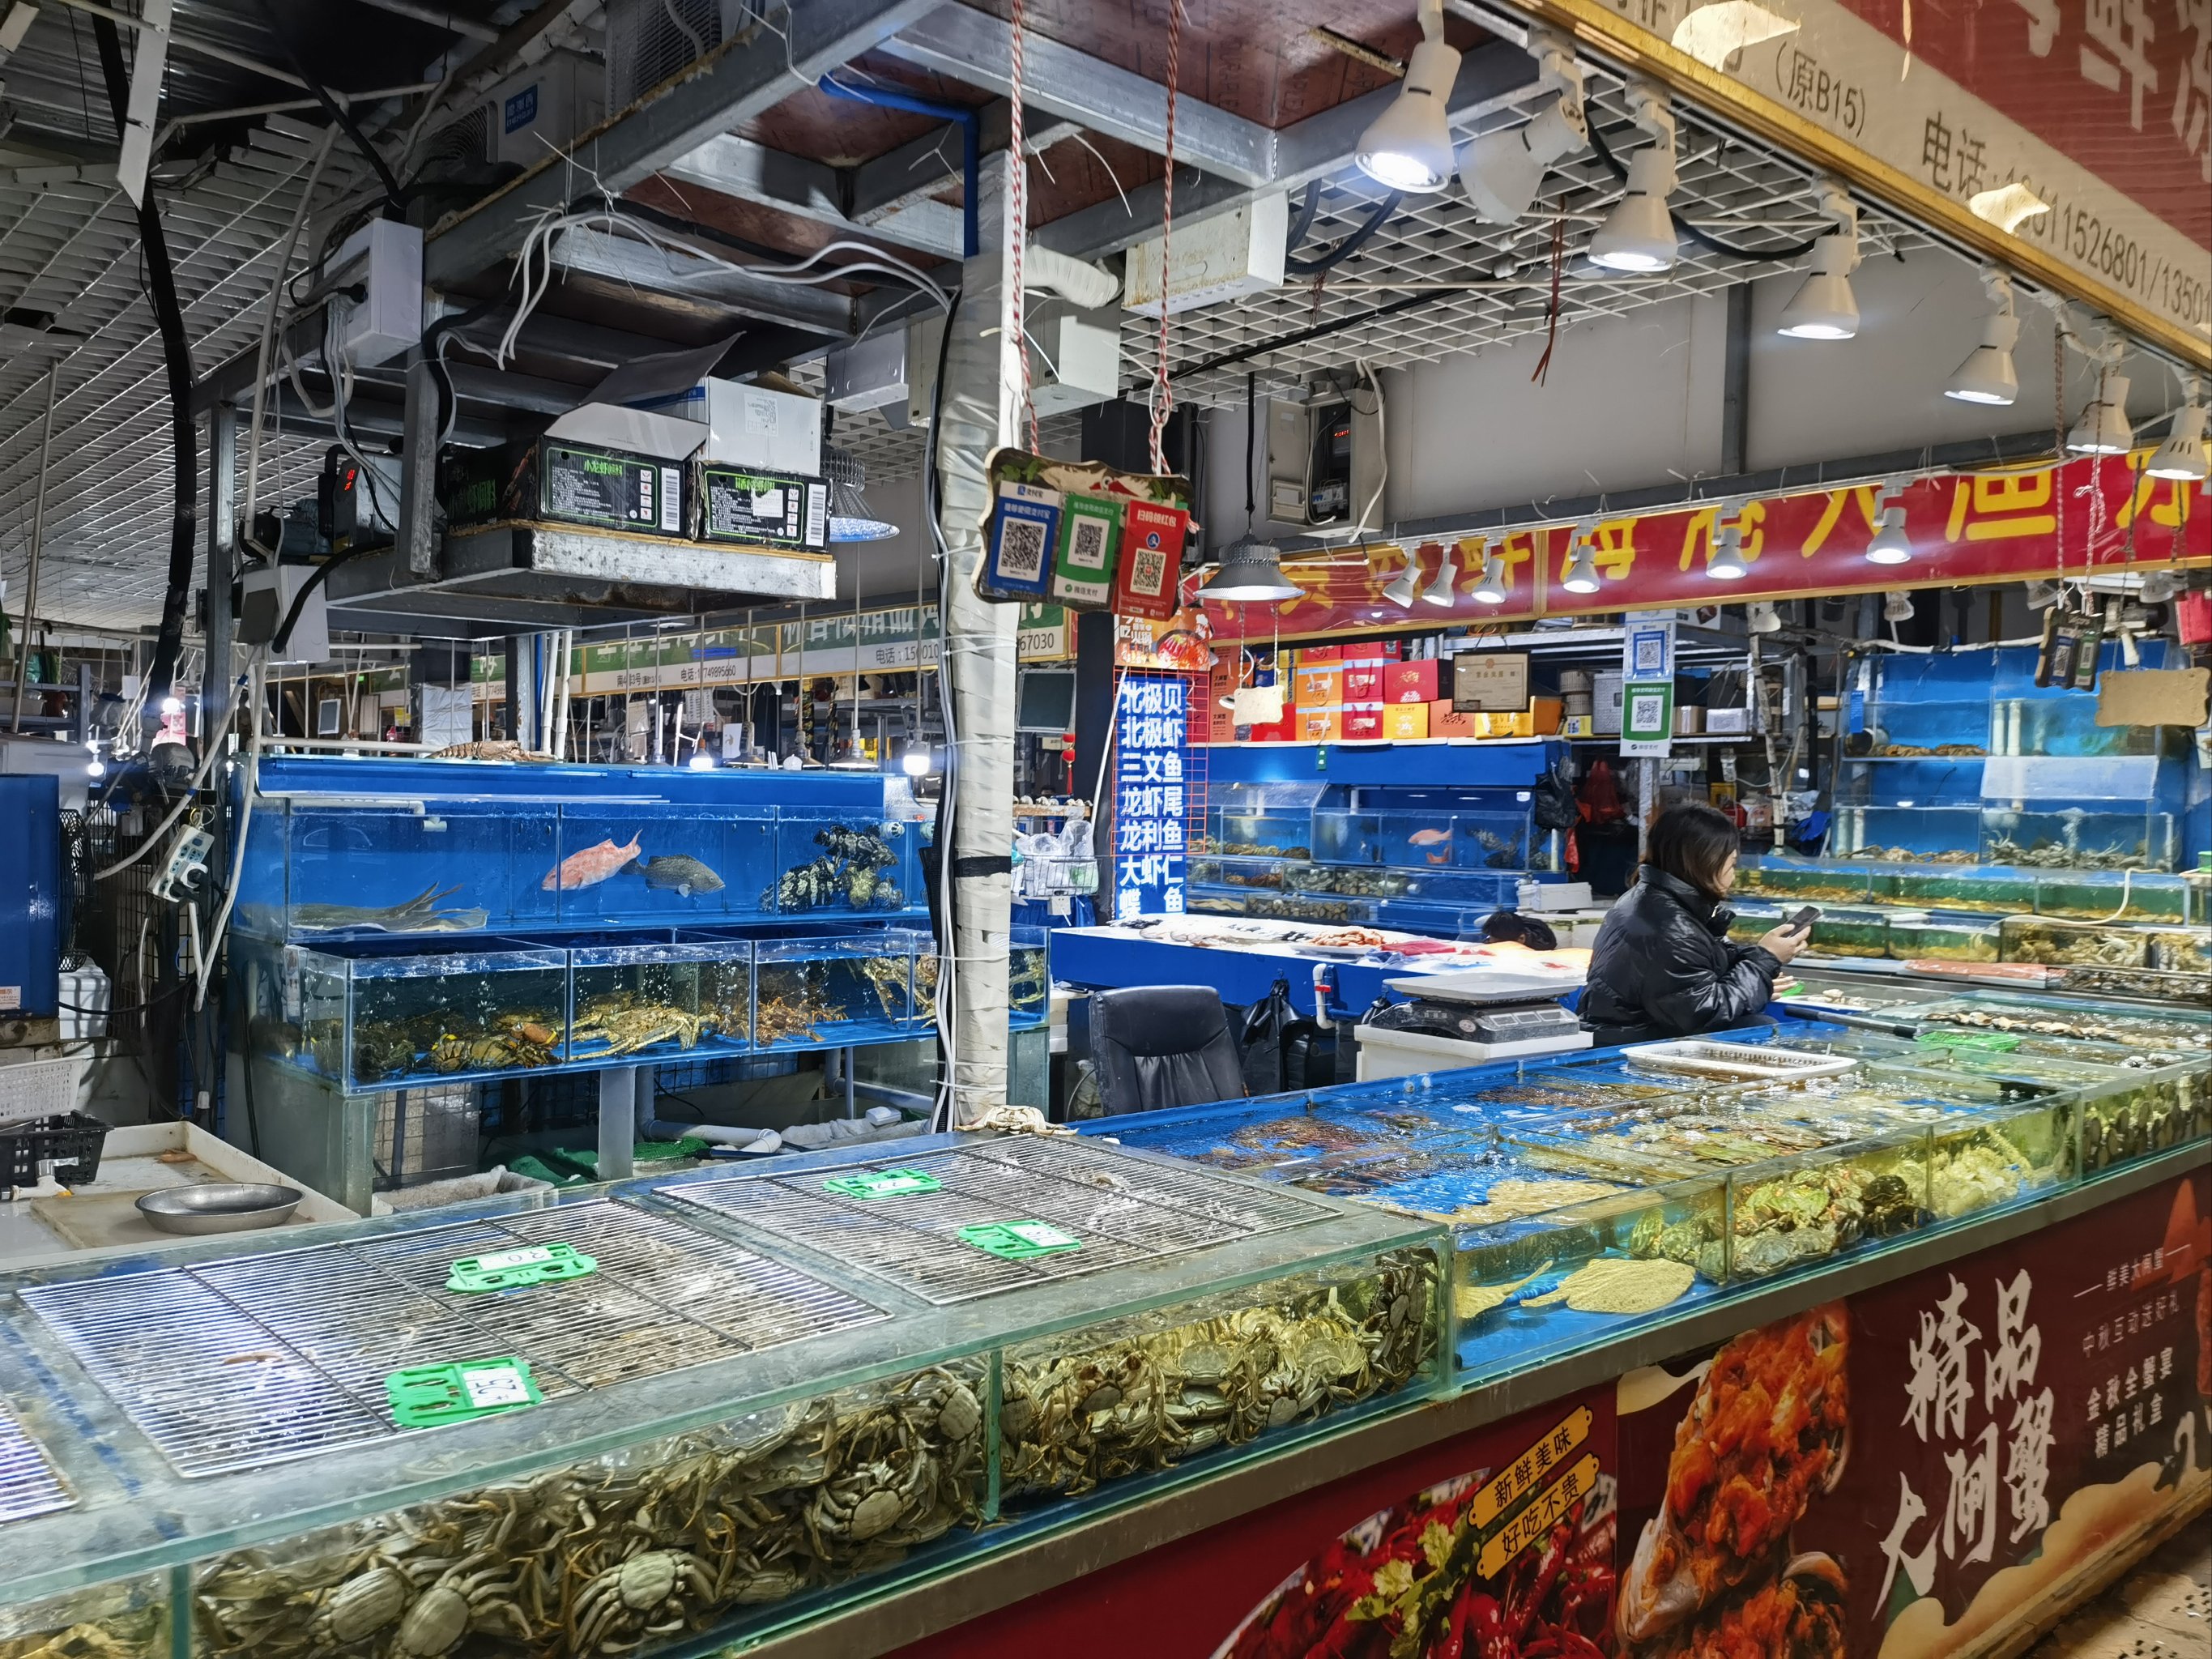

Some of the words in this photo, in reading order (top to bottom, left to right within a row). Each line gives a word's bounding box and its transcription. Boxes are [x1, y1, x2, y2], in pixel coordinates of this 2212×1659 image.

[1775, 40, 1867, 139] (原B15)
[1136, 509, 1177, 527] 扫码领红包
[1120, 681, 1183, 715] 北极贝
[1120, 716, 1183, 749] 北极虾
[1120, 750, 1183, 783] 三文鱼
[1120, 785, 1183, 819] 龙虾尾
[1119, 819, 1183, 853] 龙利鱼
[1119, 855, 1184, 887] 大虾仁
[1899, 1267, 2043, 1444] 精品
[1493, 1425, 1573, 1509] 新鲜美味
[1499, 1473, 1582, 1562] 好吃不贵
[1870, 1384, 2056, 1621] 大闸蟹
